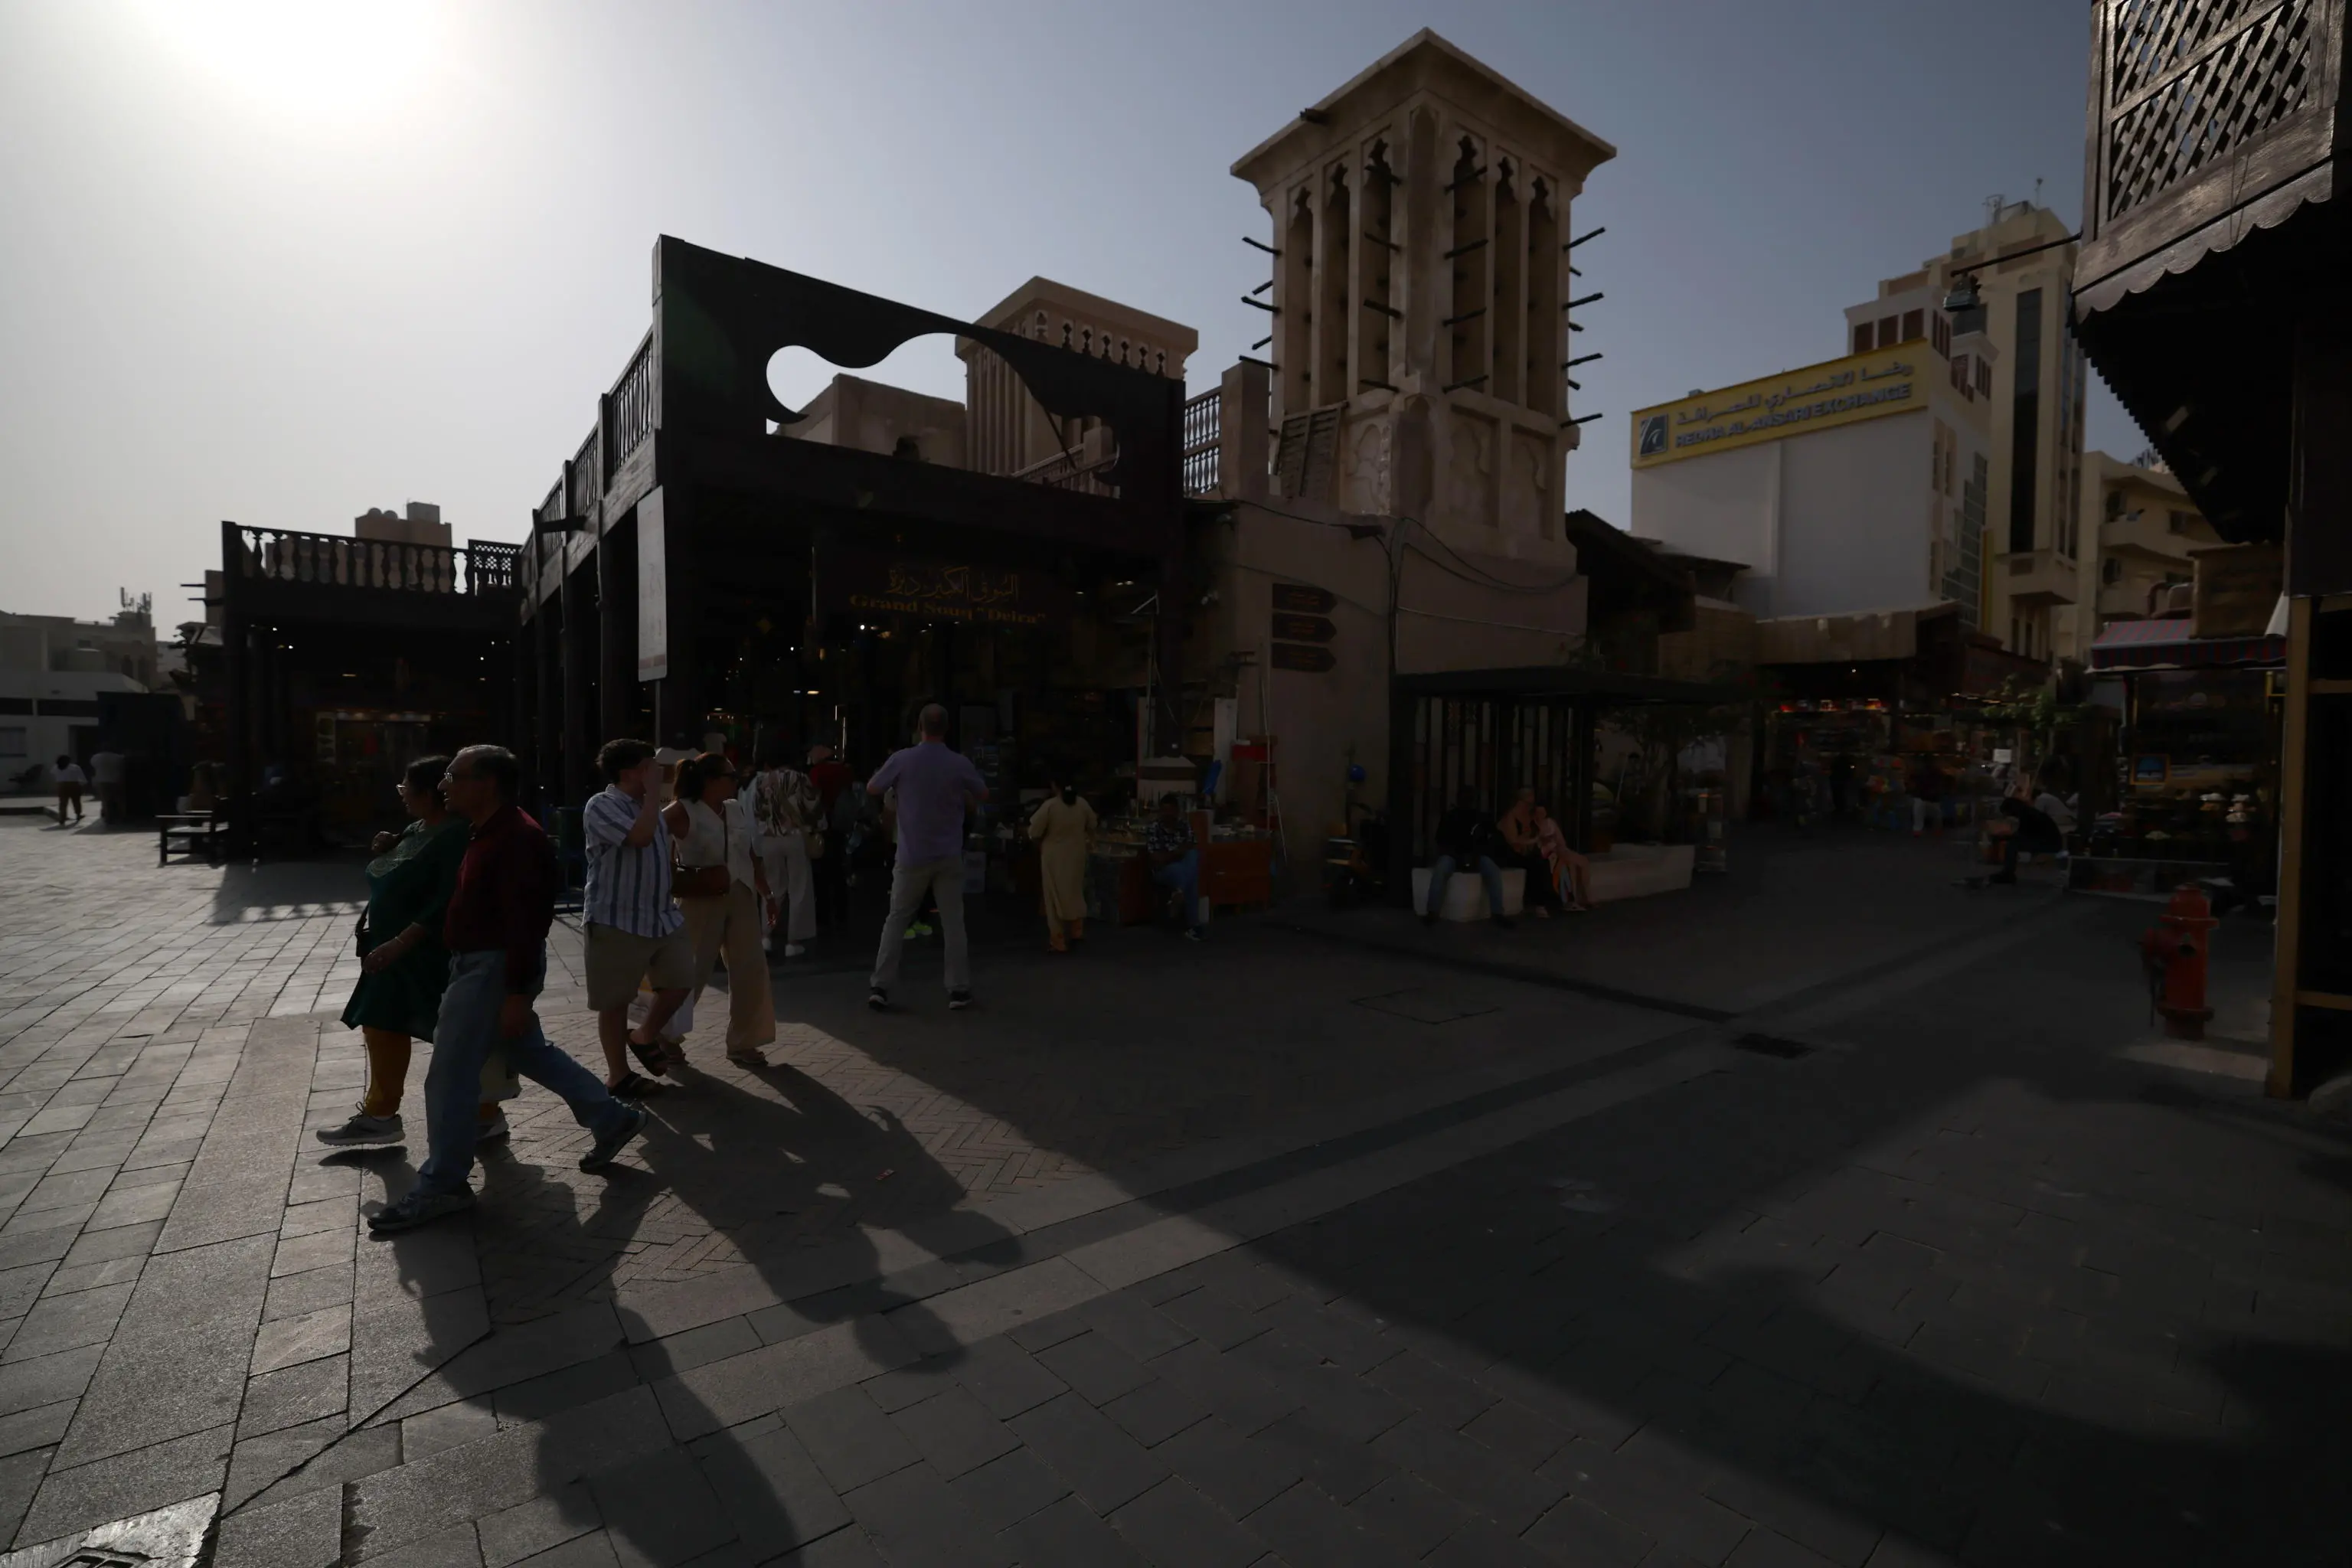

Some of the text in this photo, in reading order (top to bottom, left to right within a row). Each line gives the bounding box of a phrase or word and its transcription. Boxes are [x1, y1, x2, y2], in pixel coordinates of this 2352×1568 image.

[1675, 426, 1725, 447] REDHA
[1815, 383, 1912, 414] EXCHANGE
[848, 593, 917, 612] Grand
[923, 601, 973, 620] Souq
